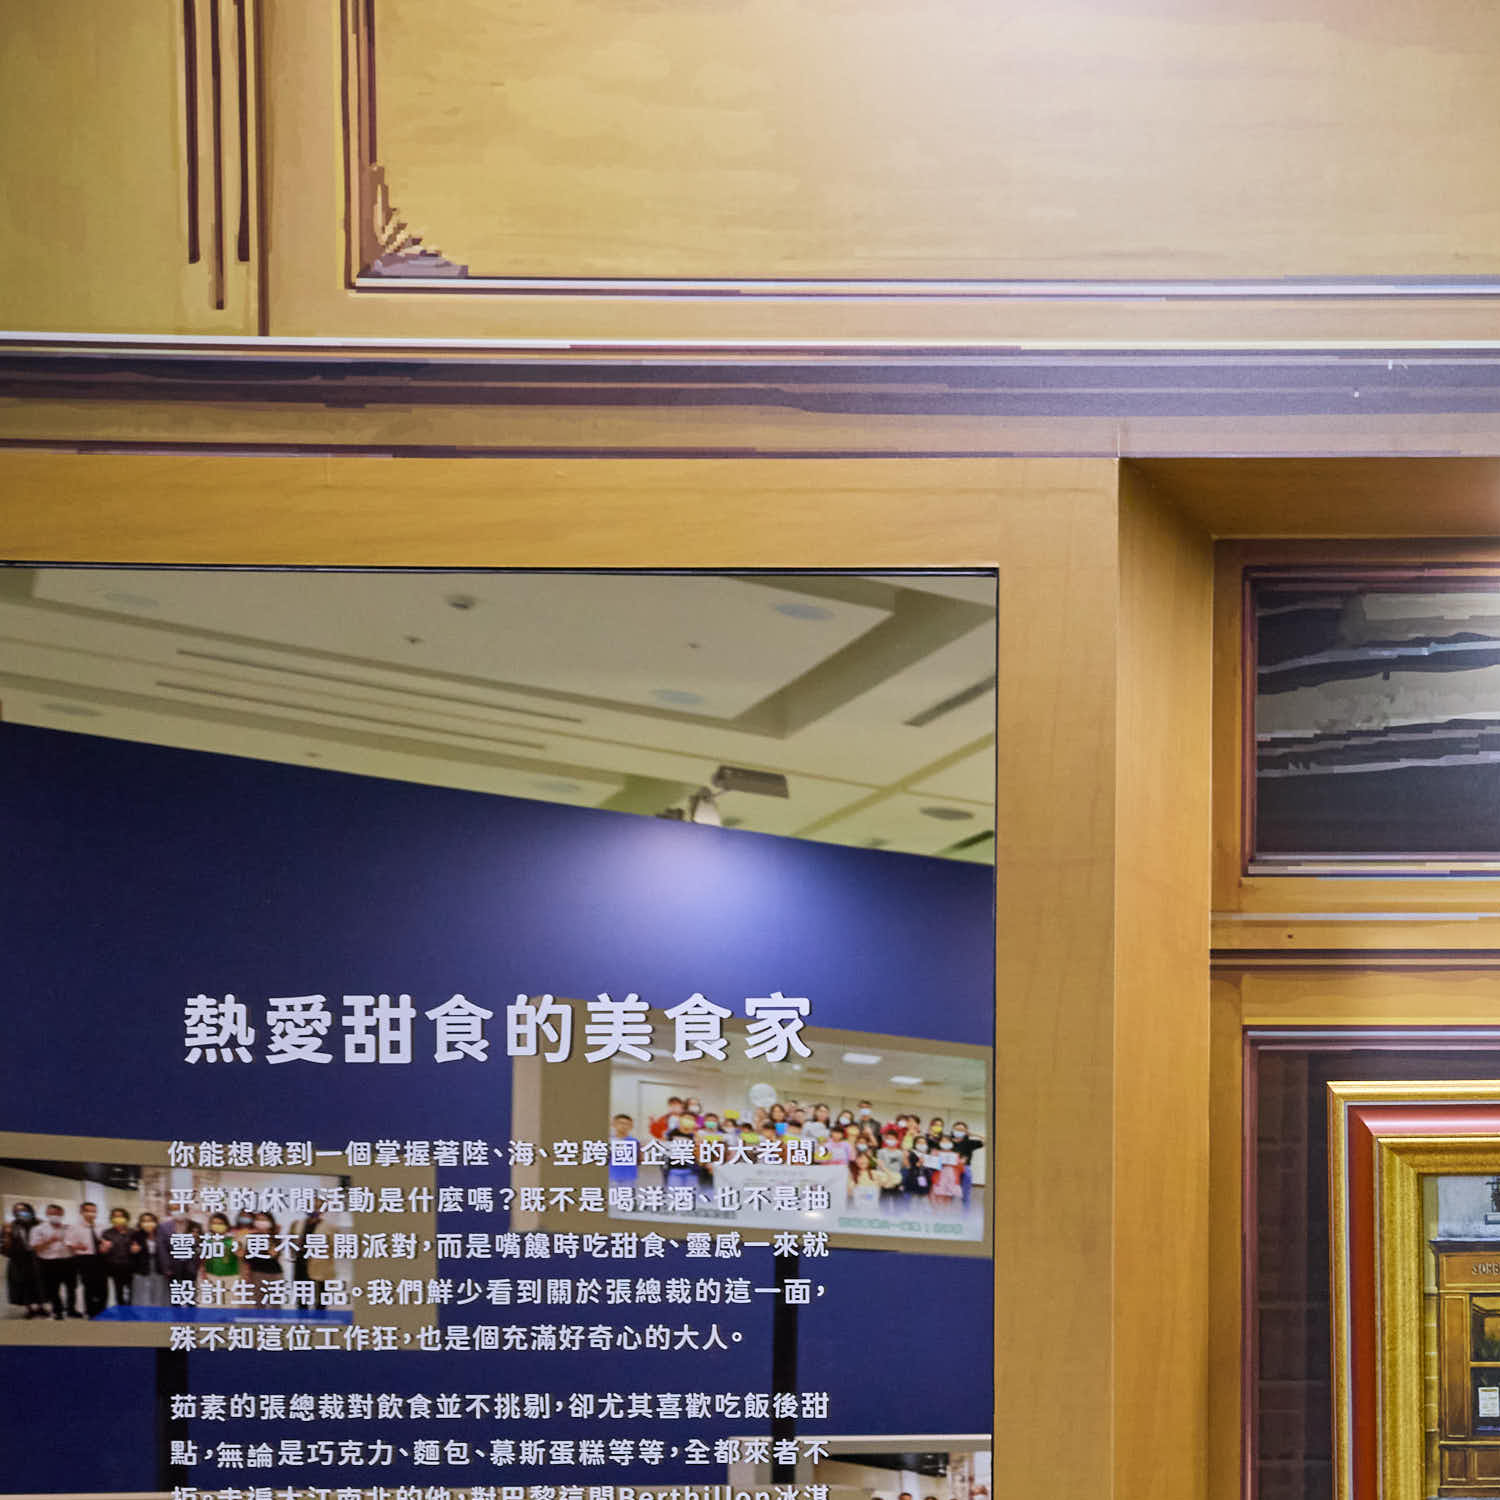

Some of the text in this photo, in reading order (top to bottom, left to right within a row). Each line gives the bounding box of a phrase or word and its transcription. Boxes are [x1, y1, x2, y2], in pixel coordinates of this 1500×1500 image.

[183, 993, 814, 1065] 熱愛甜食的美食家
